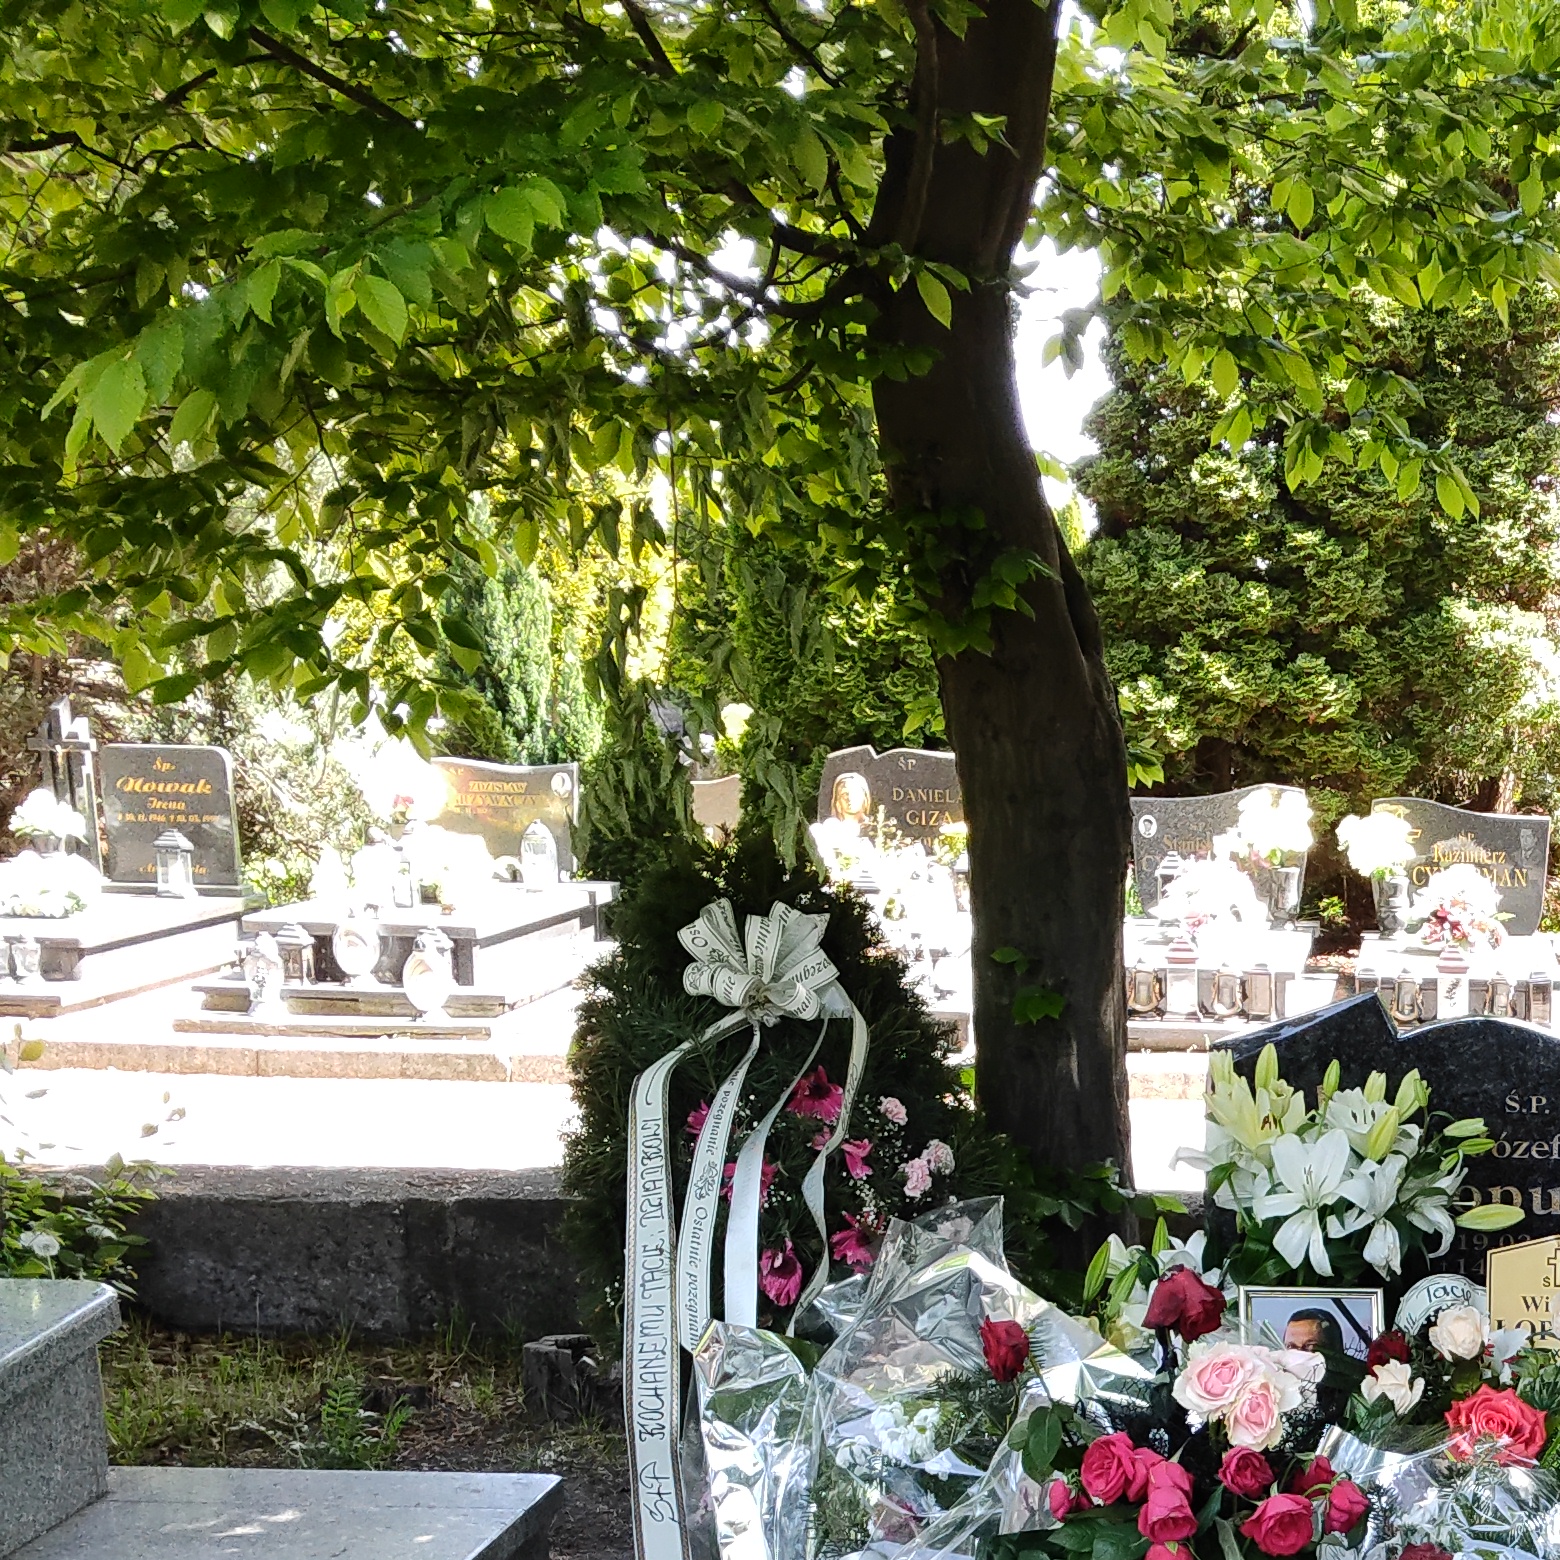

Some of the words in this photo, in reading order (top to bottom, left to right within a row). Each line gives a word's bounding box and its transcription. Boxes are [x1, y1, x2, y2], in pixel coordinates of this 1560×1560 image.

[116, 776, 212, 794] Nowak
[147, 797, 186, 810] Irena
[906, 810, 952, 826] GIZA
